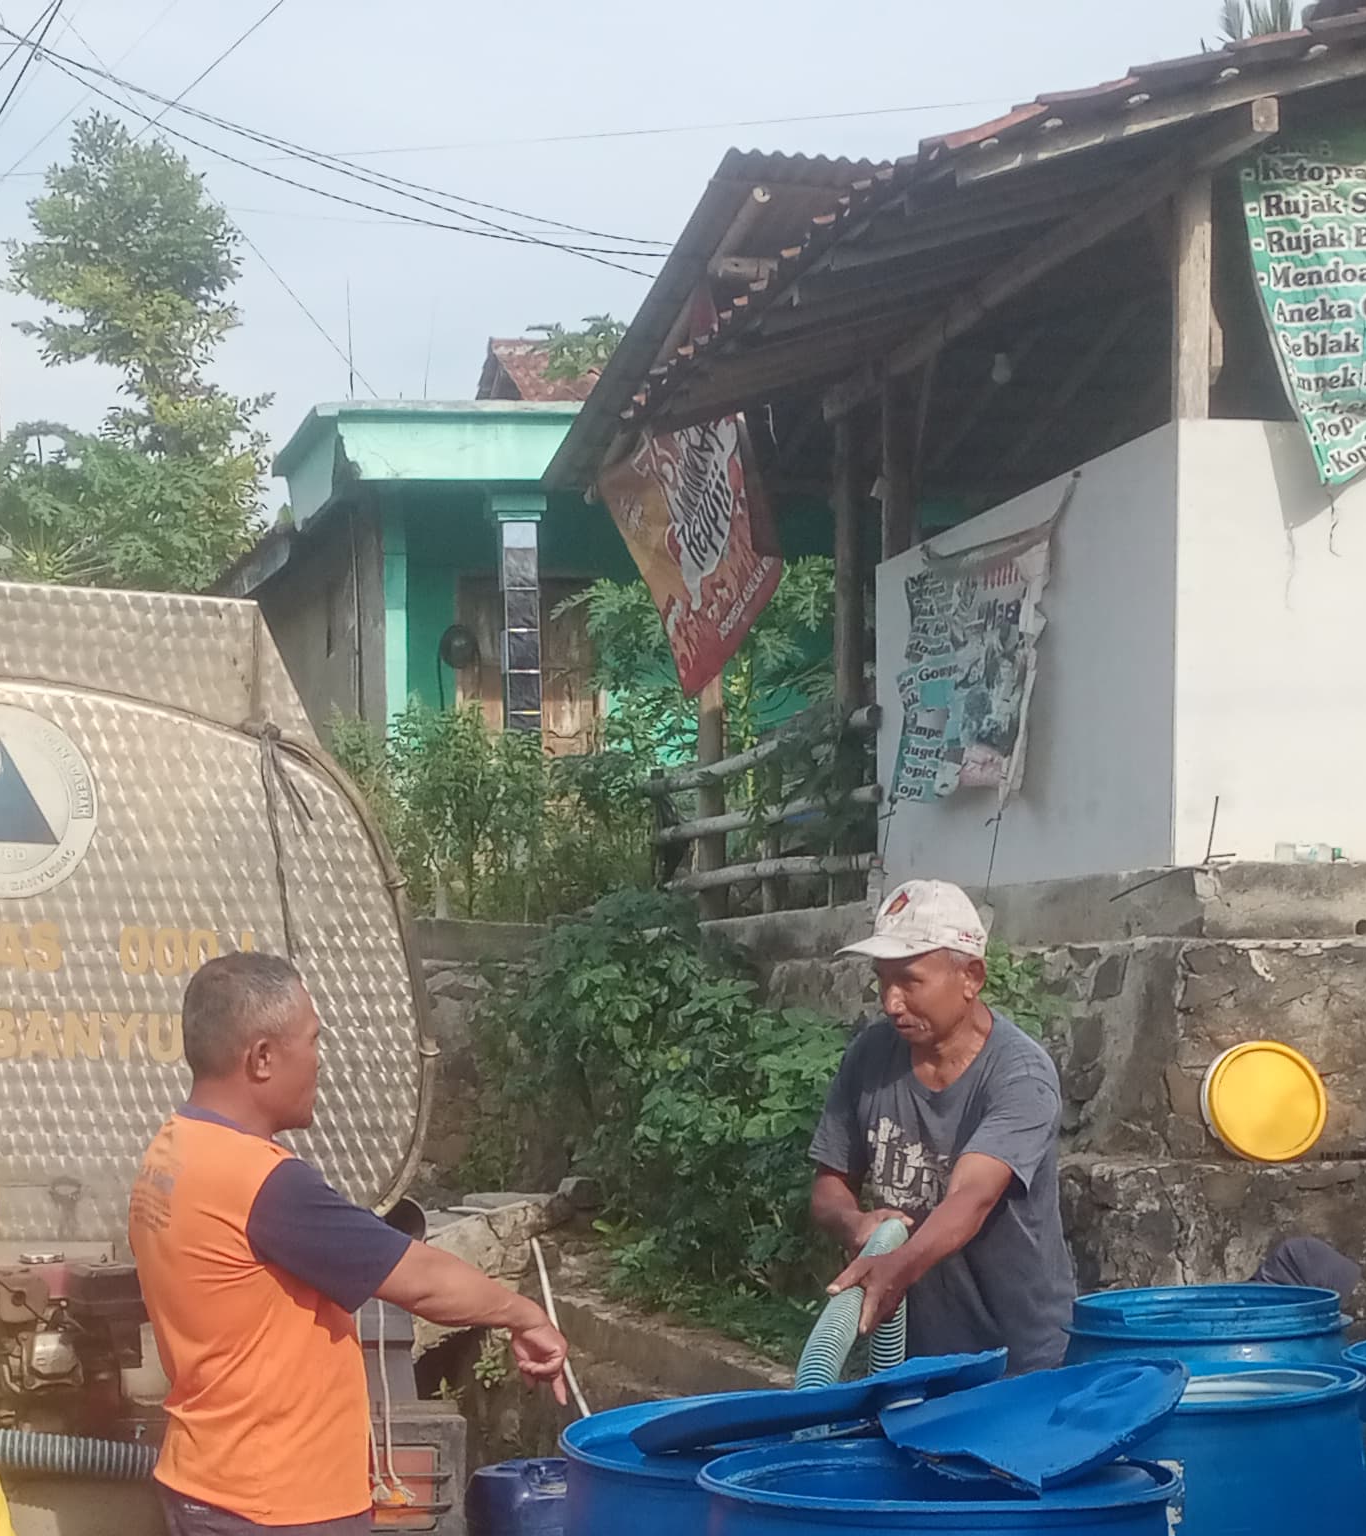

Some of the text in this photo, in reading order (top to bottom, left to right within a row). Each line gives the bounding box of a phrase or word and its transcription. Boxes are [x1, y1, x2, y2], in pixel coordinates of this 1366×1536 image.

[1262, 194, 1343, 218] Rujak
[1266, 227, 1346, 255] Rujak
[1276, 298, 1353, 324] Aneka
